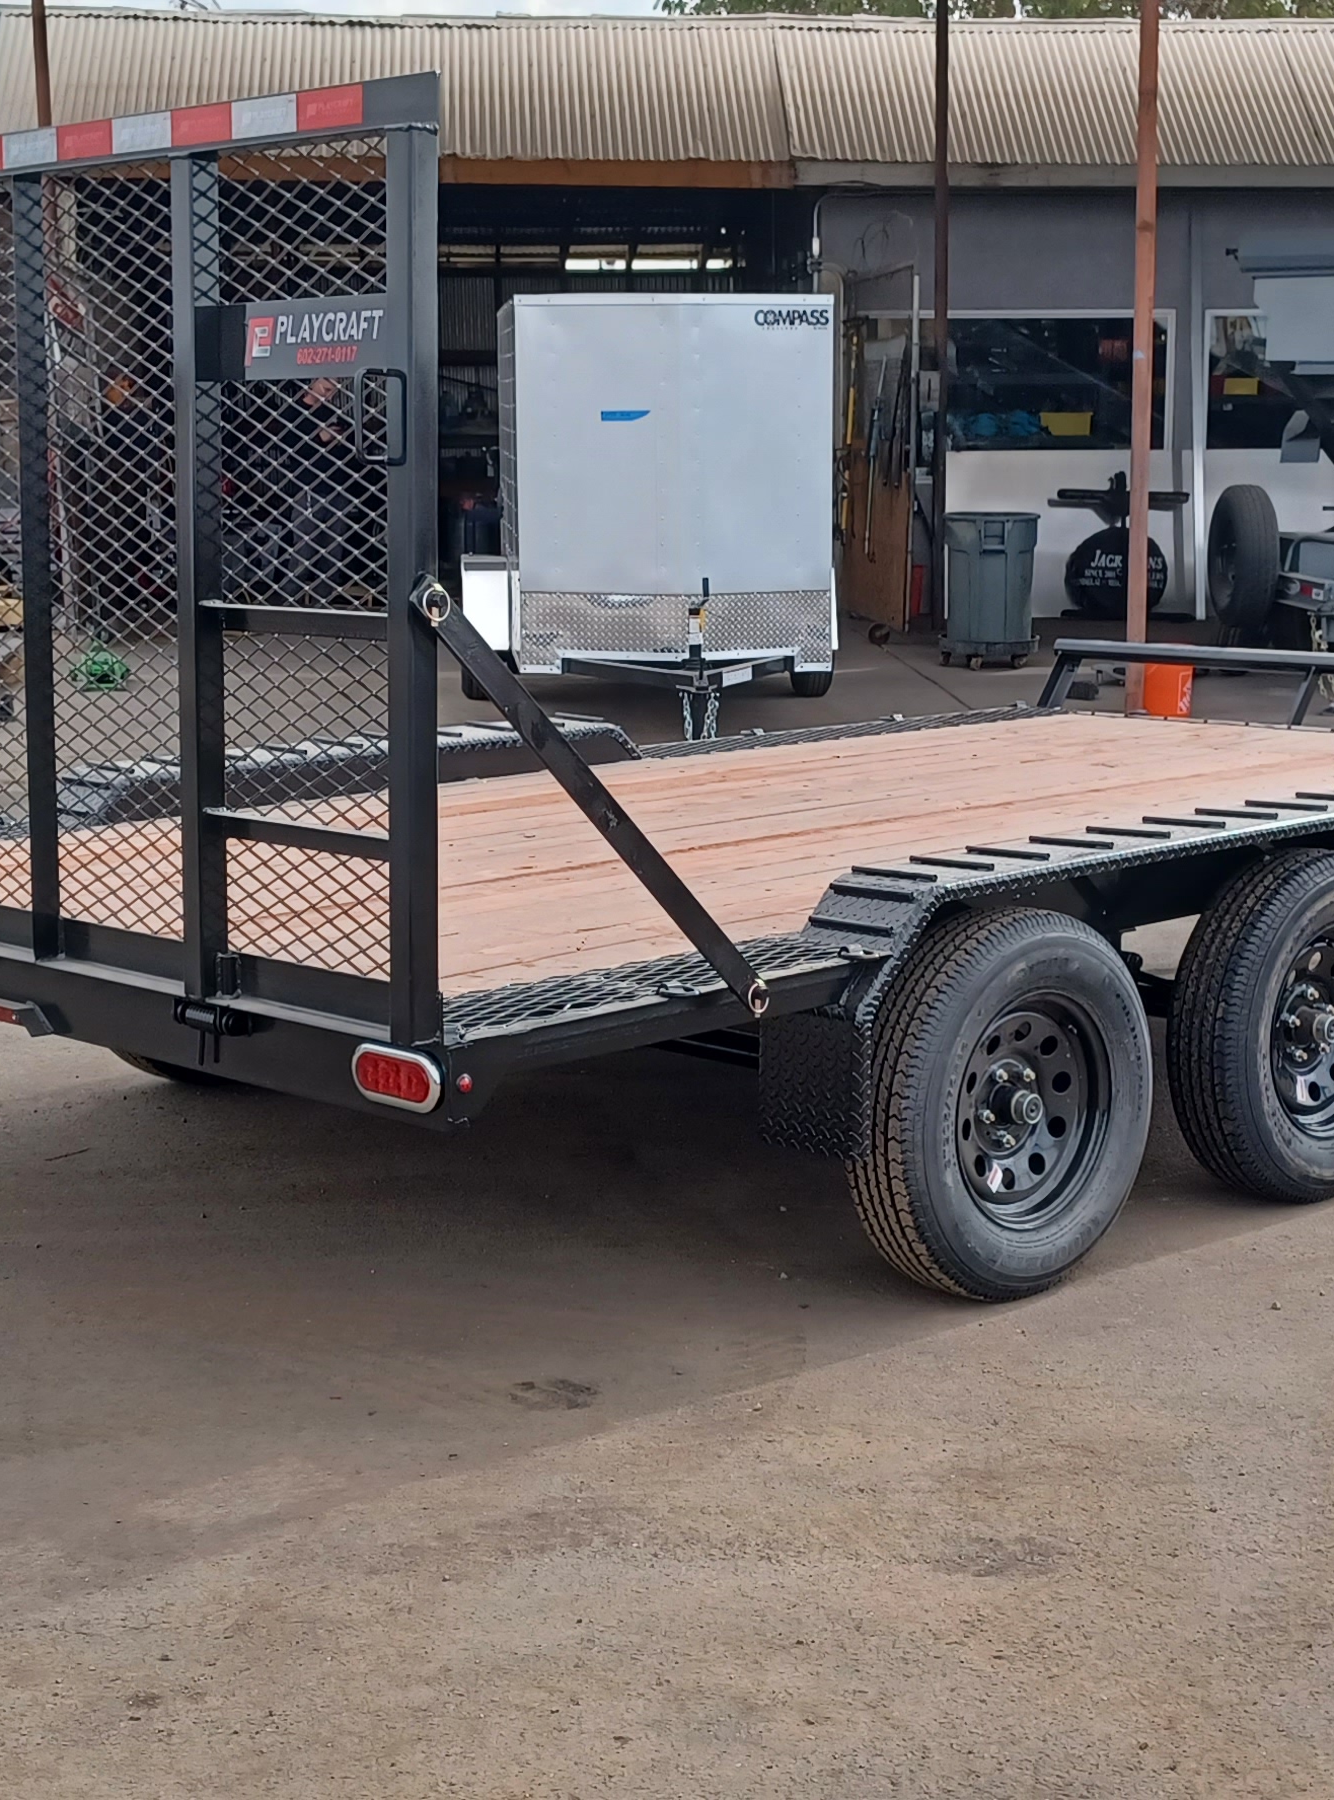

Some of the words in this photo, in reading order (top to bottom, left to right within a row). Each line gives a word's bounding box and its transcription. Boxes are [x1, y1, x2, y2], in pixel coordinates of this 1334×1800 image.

[275, 309, 384, 344] PLAYCRAFT
[754, 309, 830, 326] COMPASS
[296, 346, 358, 365] 602-271-0117
